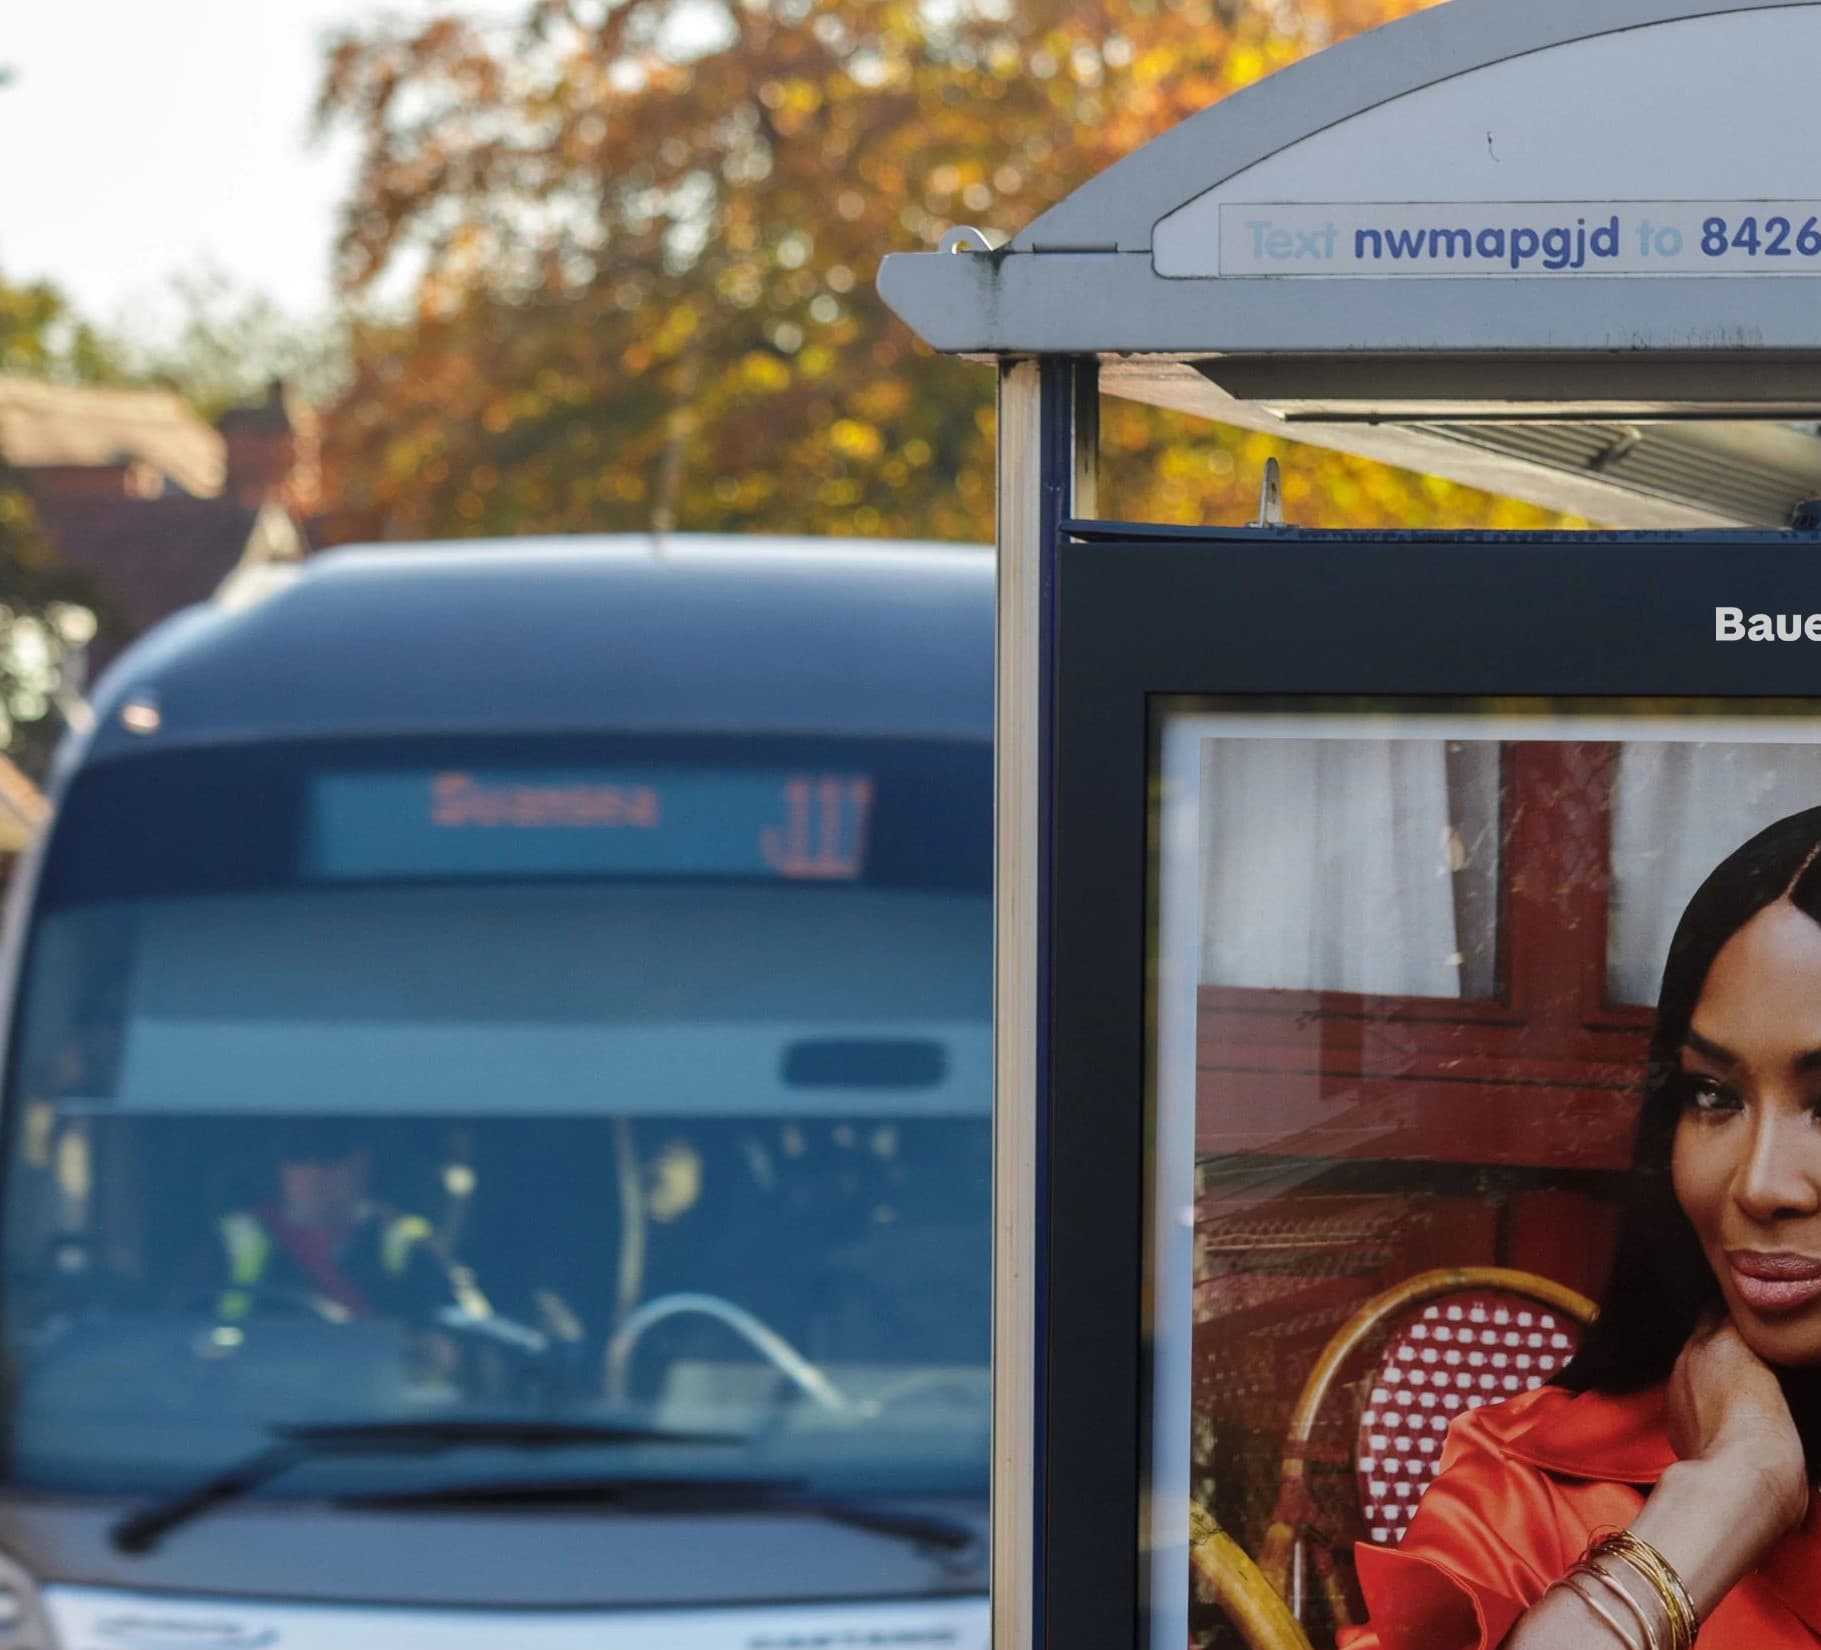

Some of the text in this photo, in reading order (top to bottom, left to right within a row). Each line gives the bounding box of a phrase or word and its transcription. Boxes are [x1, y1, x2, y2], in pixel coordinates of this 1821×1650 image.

[1246, 220, 1338, 260] Text
[1355, 216, 1619, 269] nwmapgjd
[1636, 220, 1683, 257] to
